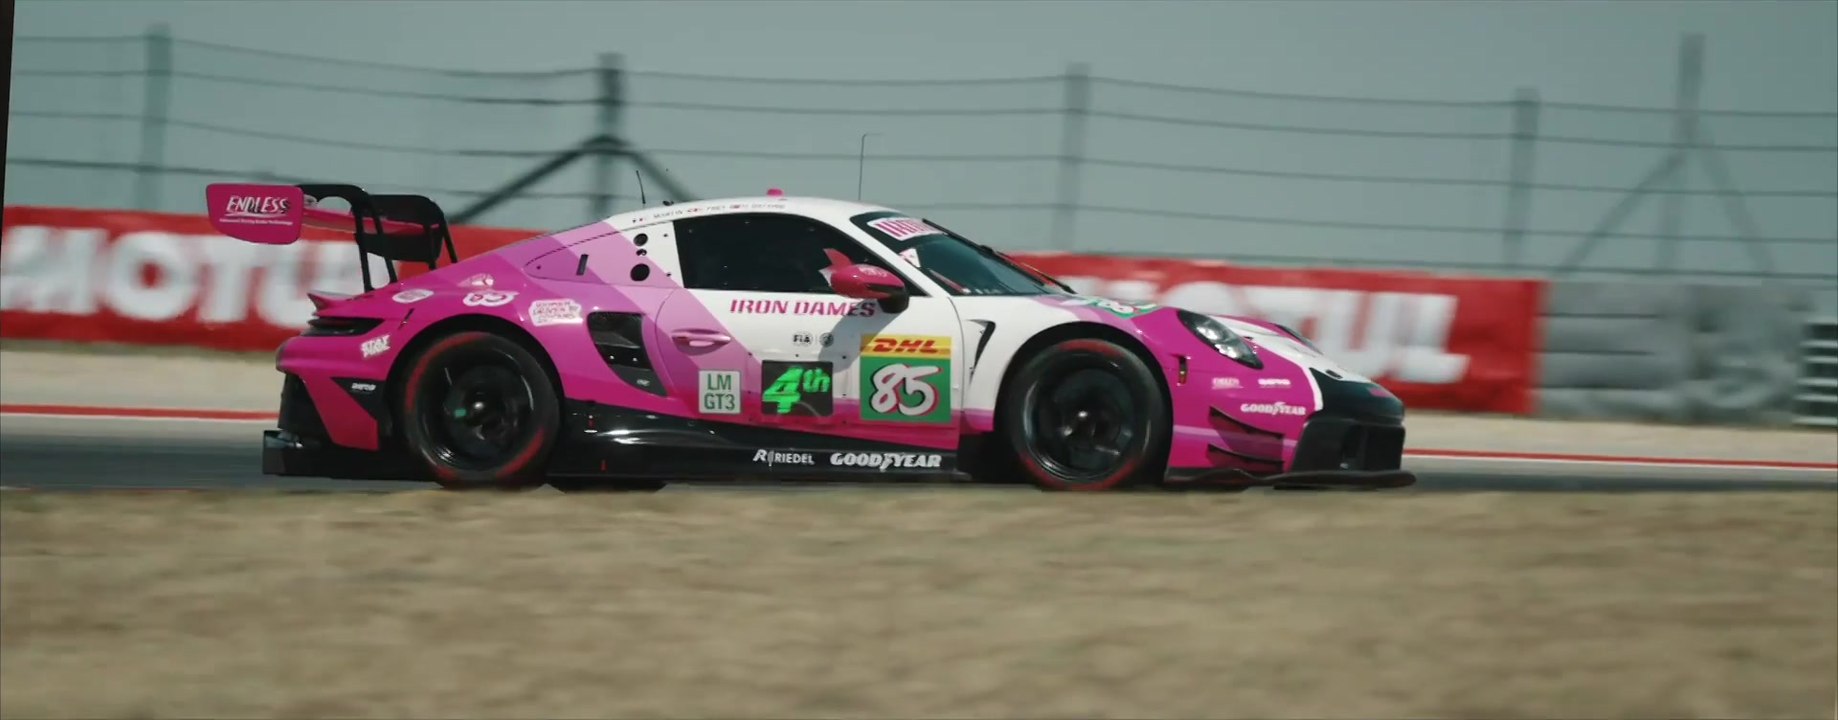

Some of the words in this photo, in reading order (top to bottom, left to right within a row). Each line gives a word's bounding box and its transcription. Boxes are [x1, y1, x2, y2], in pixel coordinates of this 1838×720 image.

[226, 195, 288, 214] ENDLESS
[730, 298, 788, 314] IRON
[794, 301, 876, 317] DAMES
[873, 337, 939, 354] DHL
[707, 373, 732, 391] LM
[762, 367, 830, 414] 4th
[870, 363, 941, 416] 85
[703, 394, 736, 411] GT3
[1240, 401, 1306, 416] GOODYEAR
[774, 451, 815, 465] RIEDEL
[830, 452, 943, 472] GOODYEAR
